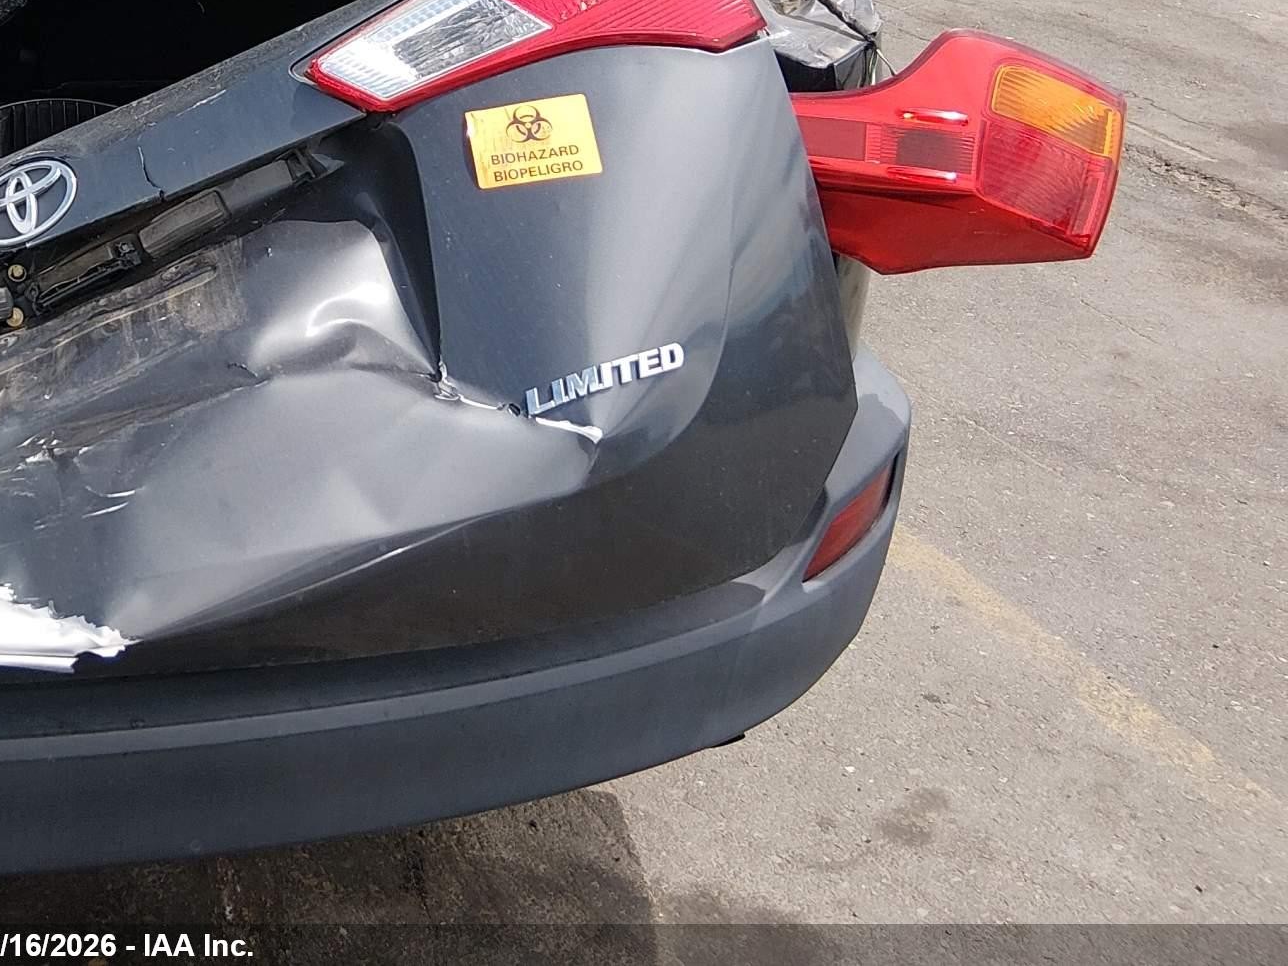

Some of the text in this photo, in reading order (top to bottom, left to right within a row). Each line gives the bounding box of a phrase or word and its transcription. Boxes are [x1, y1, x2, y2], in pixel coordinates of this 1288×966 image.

[491, 144, 579, 165] BIOHAZARD
[494, 160, 583, 182] BIOPELIGRO
[525, 342, 684, 418] LIMITED
